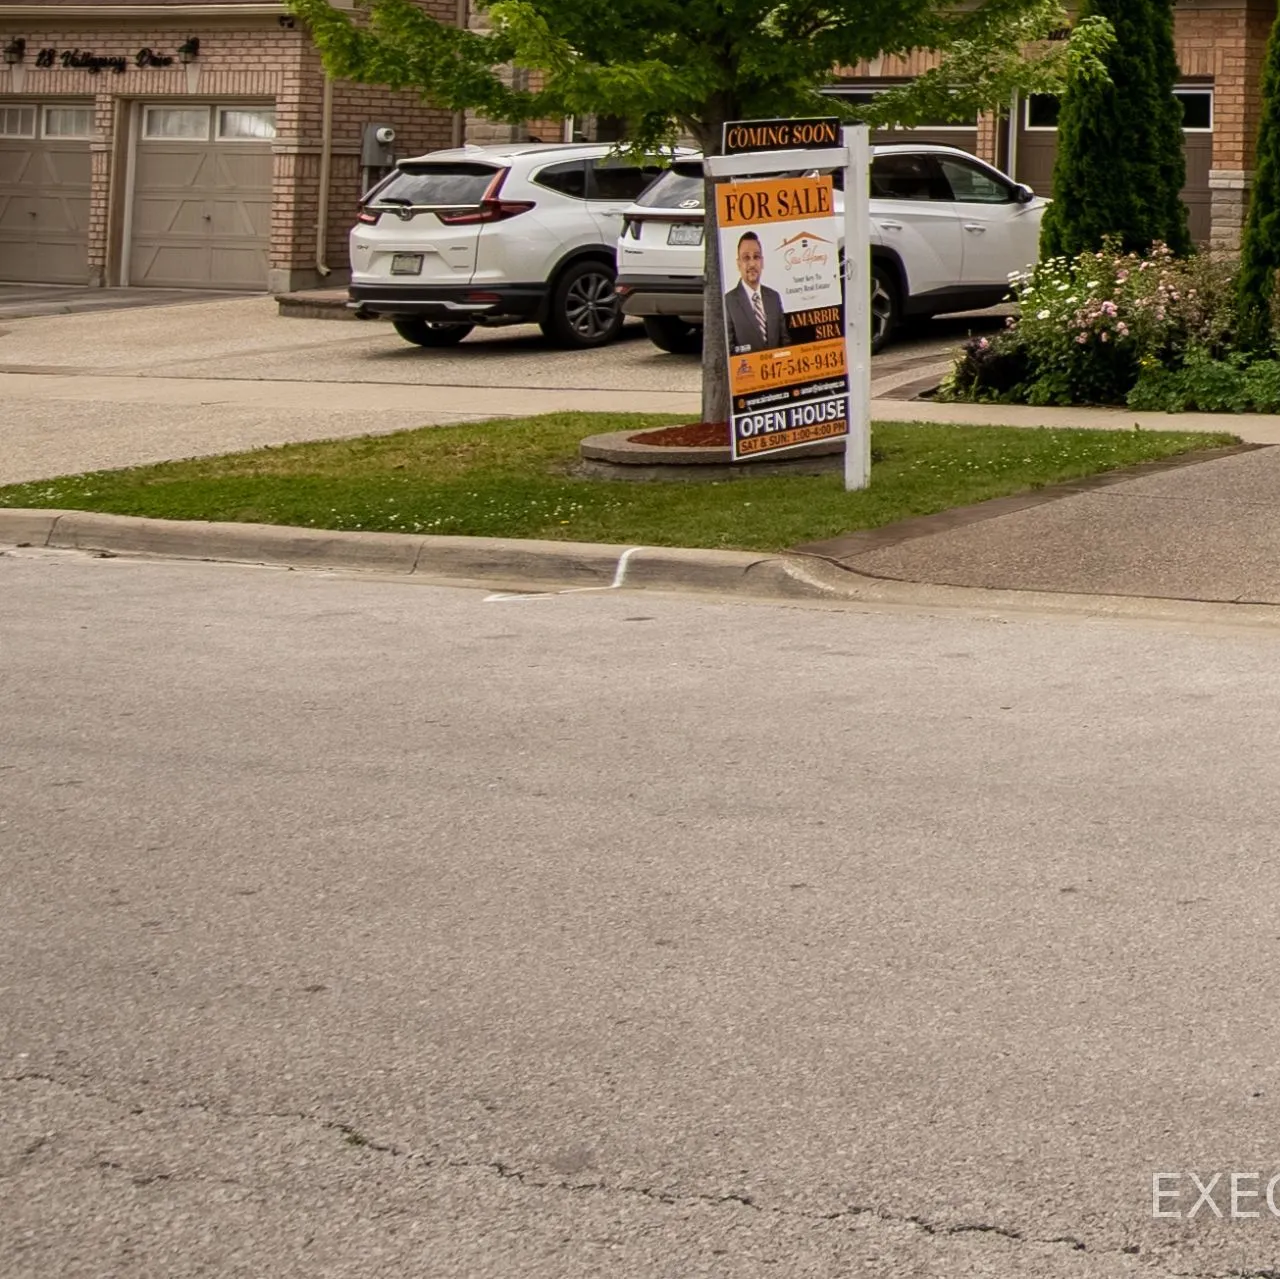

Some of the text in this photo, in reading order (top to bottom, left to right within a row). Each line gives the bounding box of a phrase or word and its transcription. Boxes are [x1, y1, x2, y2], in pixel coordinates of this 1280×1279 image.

[728, 122, 837, 149] COMING SOON
[725, 186, 830, 223] FOR SALE
[790, 307, 840, 328] AMARBIR
[815, 324, 841, 340] SIRA
[760, 350, 844, 381] 647-548-9434
[741, 400, 846, 436] OPEN HOUSE
[741, 421, 845, 452] SAT & SUN: 1:00-4:00 PM
